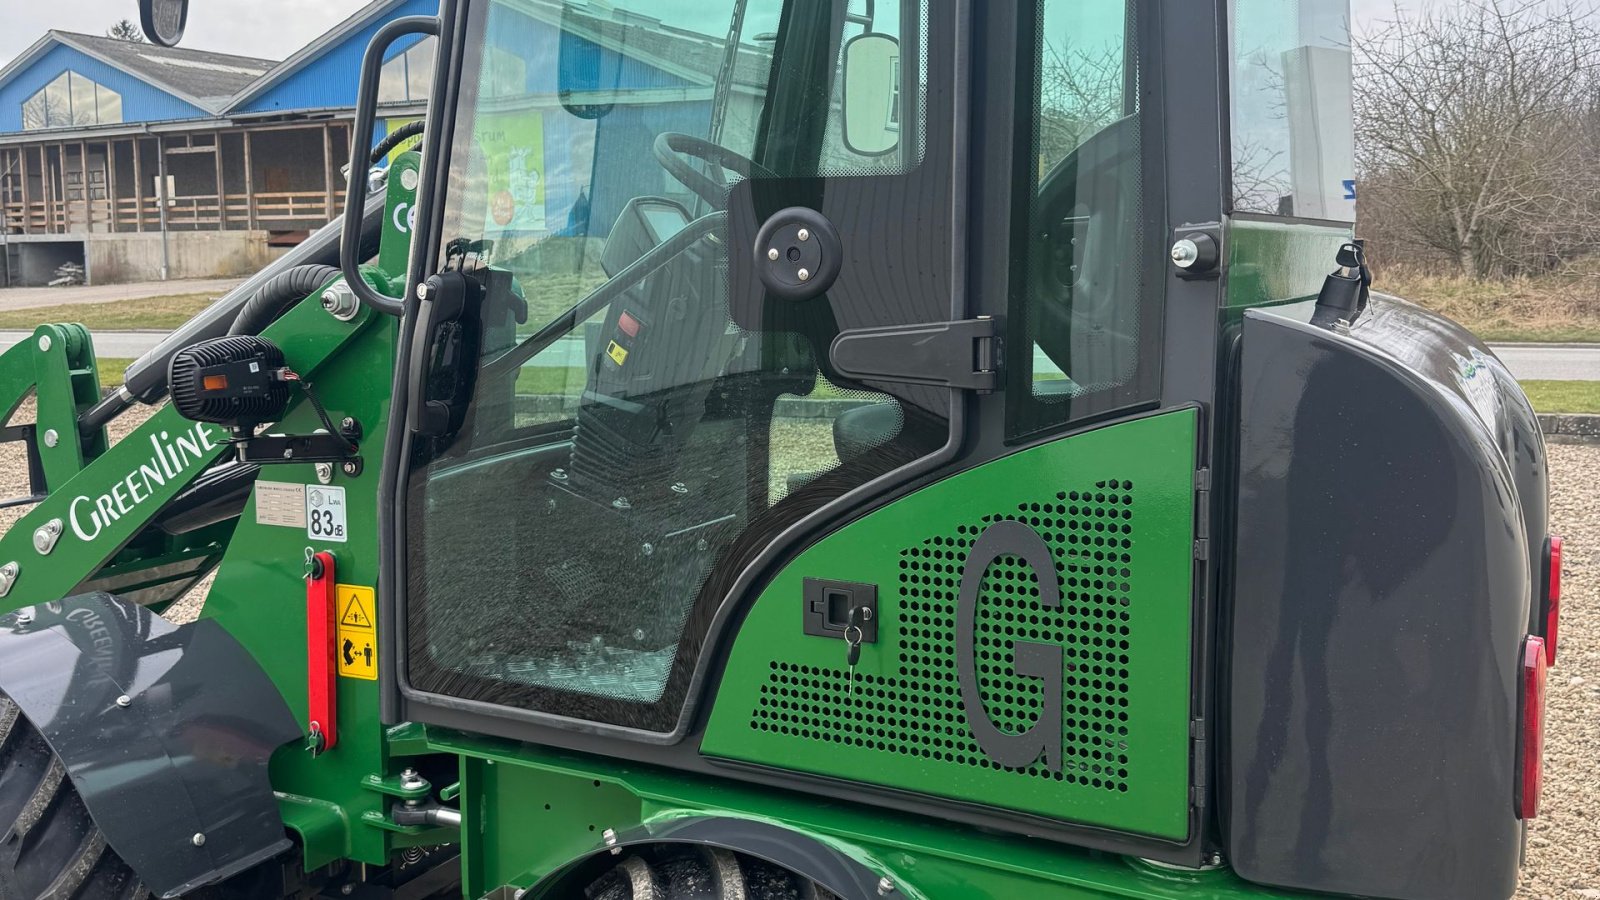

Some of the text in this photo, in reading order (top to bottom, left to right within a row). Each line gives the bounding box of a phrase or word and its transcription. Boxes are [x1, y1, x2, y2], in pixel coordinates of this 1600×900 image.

[311, 509, 343, 536] 83 dB
[956, 520, 1063, 772] G
